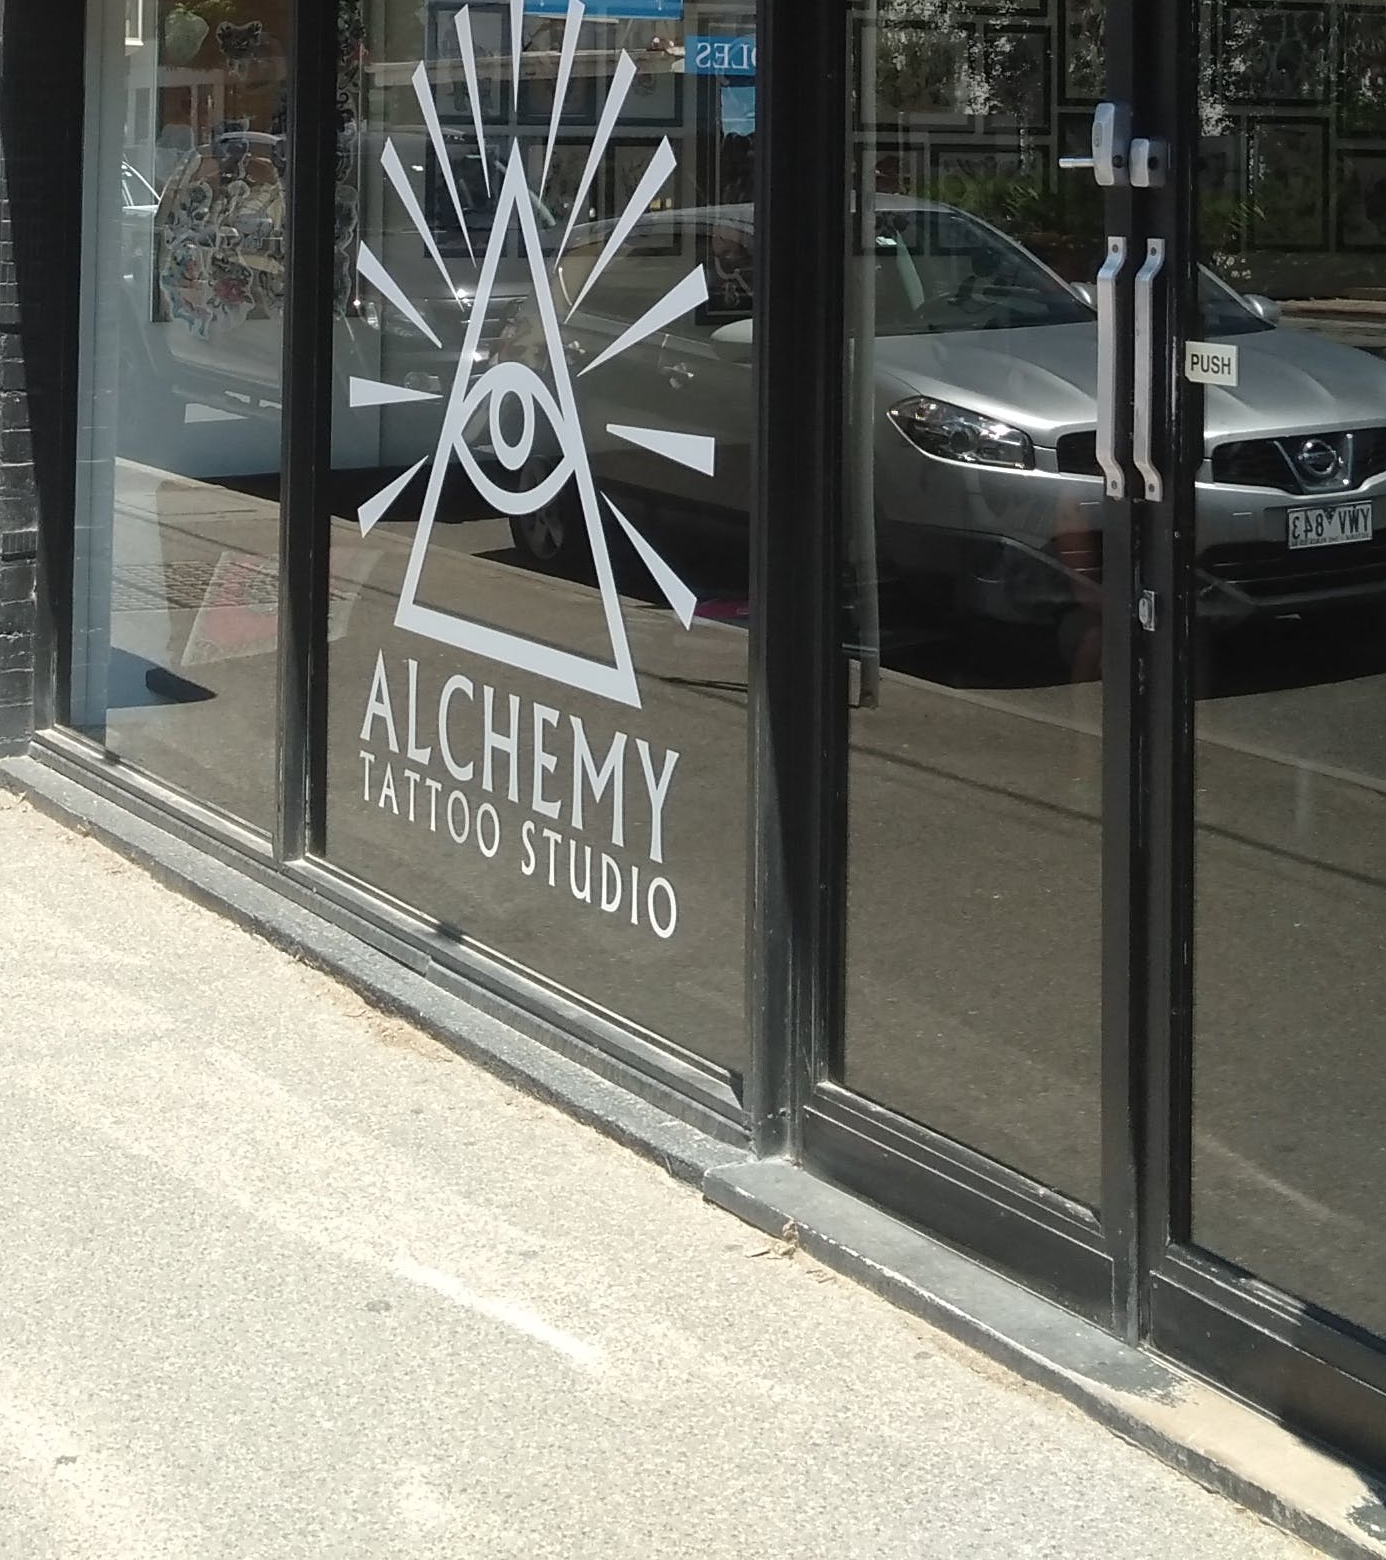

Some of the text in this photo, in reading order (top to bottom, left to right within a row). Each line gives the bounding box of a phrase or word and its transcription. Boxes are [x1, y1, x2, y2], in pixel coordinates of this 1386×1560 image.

[1190, 353, 1231, 375] PUSH
[359, 648, 679, 864] ALCHEMY
[359, 750, 677, 938] TATTOO STUDIO
